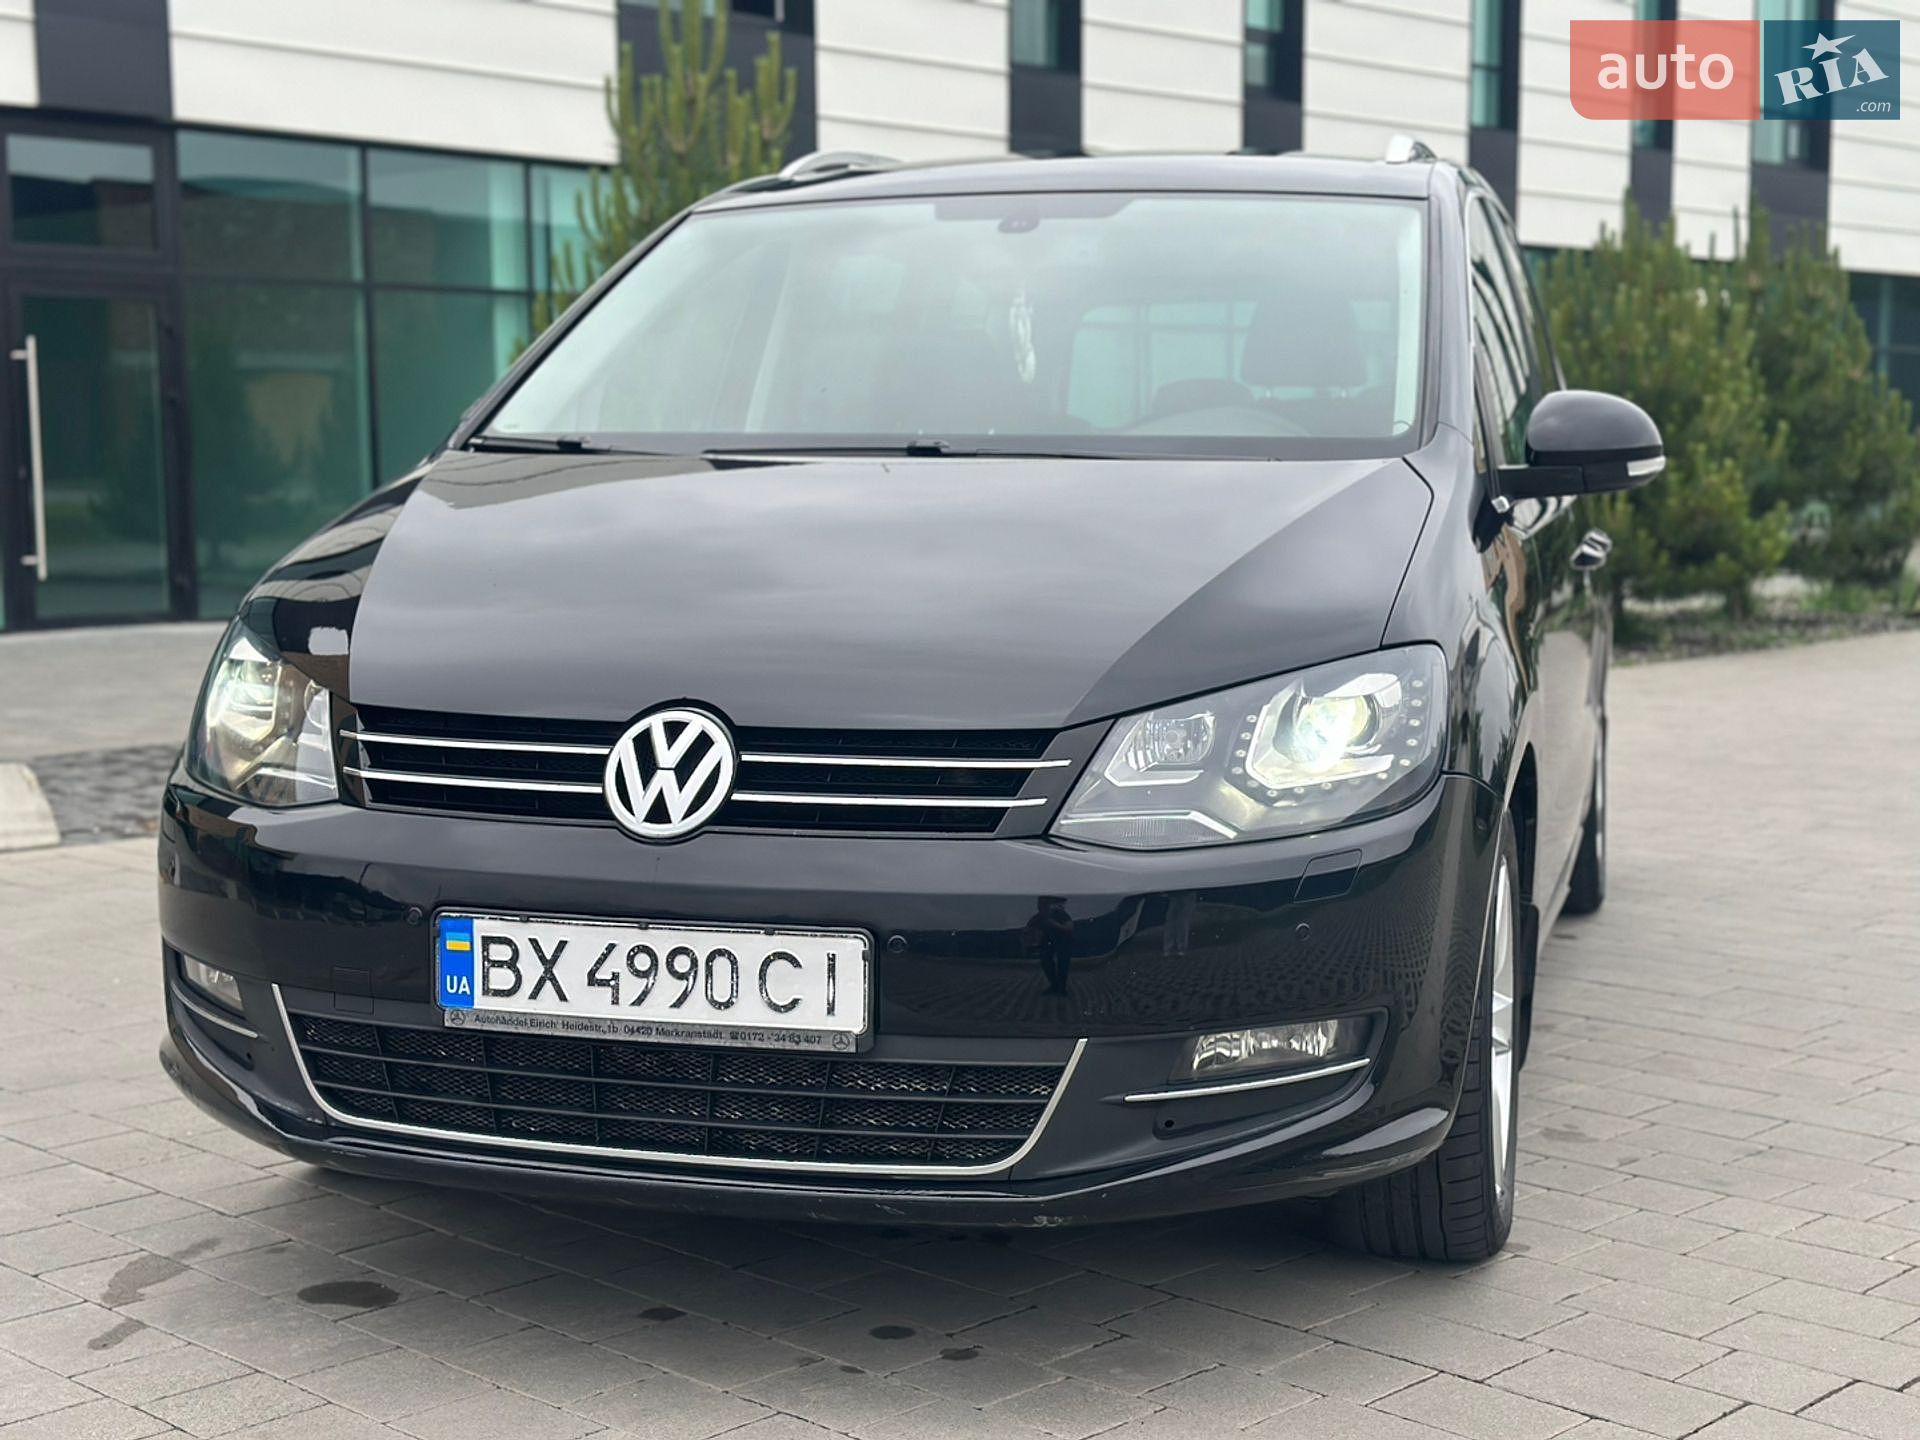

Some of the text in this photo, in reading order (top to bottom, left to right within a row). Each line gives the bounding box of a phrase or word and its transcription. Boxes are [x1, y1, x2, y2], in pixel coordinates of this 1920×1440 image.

[446, 975, 471, 996] UA
[480, 935, 569, 1003] BX
[587, 942, 739, 1011] 4990
